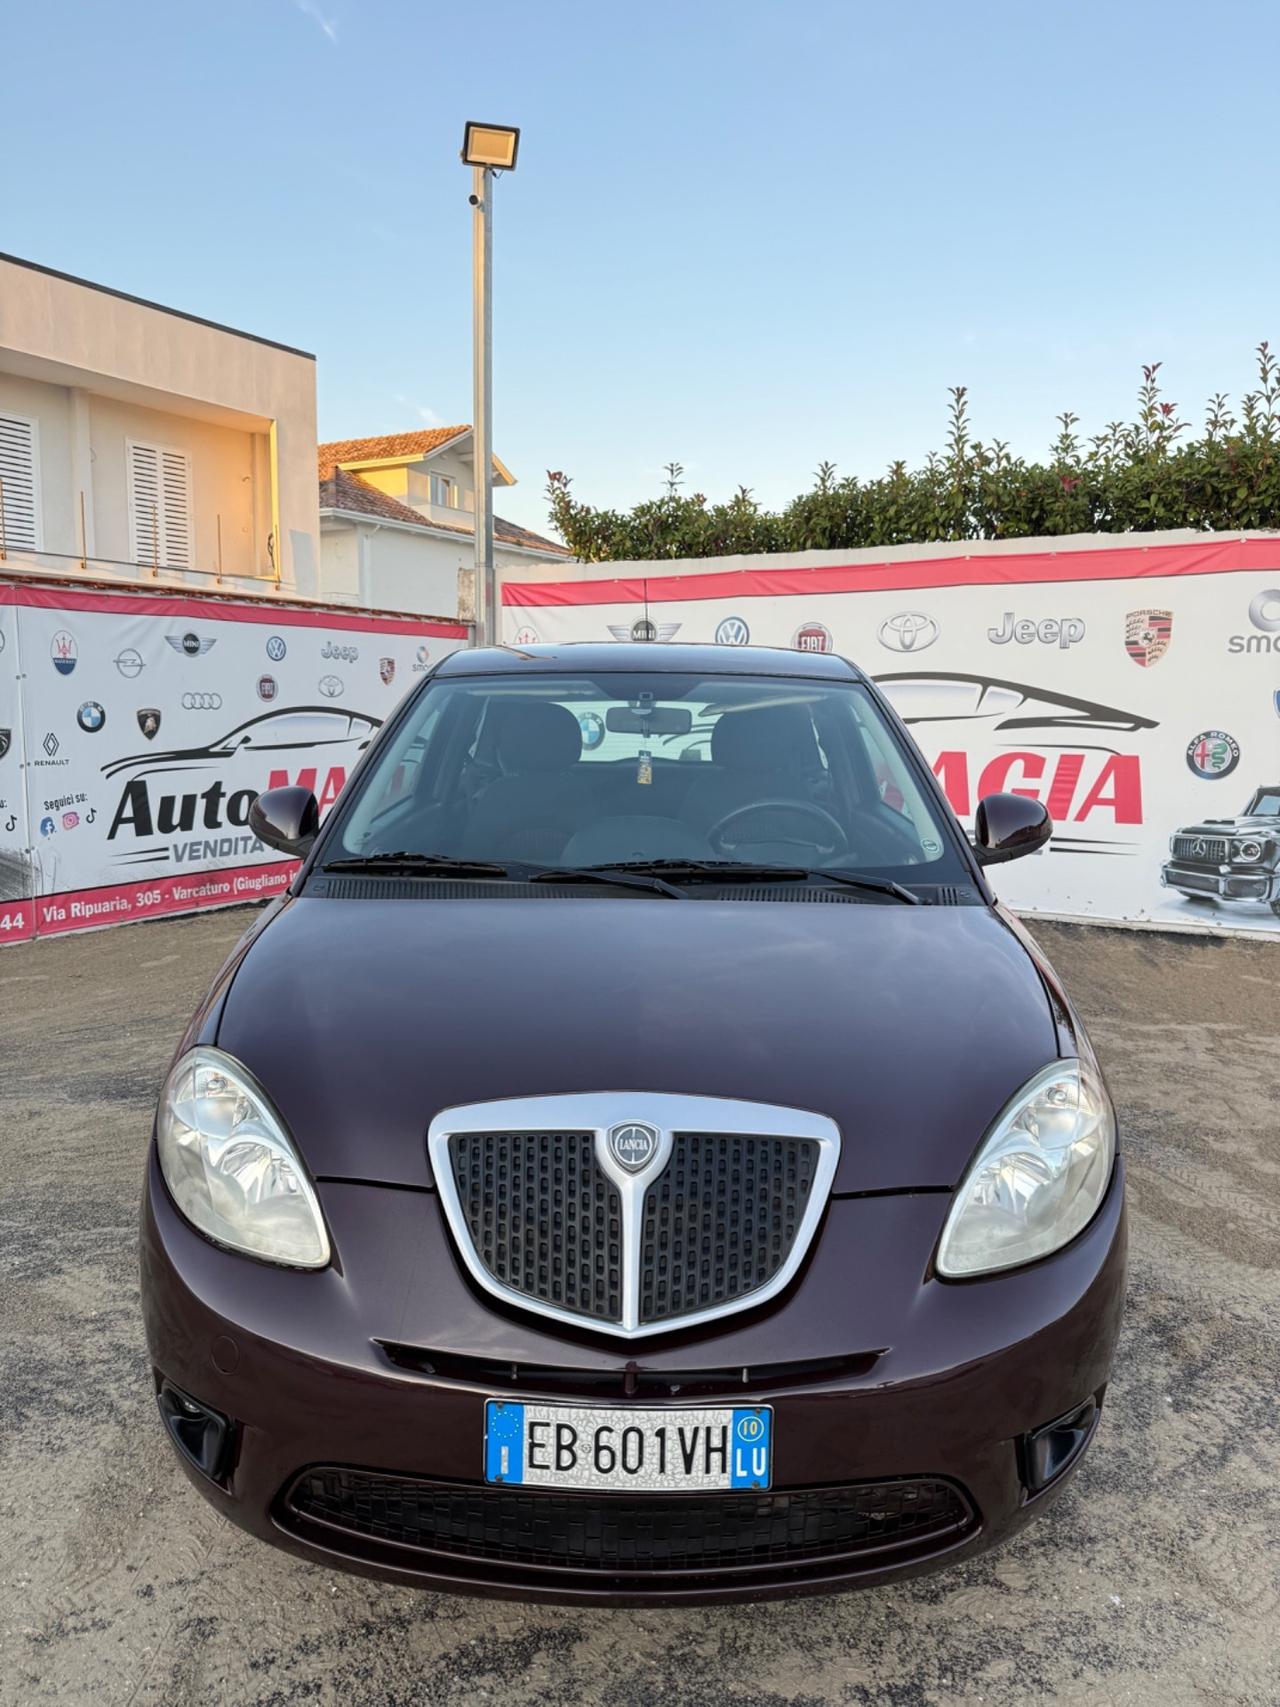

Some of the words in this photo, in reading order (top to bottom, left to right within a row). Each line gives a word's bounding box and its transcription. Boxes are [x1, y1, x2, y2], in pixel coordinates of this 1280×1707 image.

[988, 612, 1086, 649] Jeep
[320, 641, 359, 663] Jeep
[801, 636, 825, 651] FIAT
[34, 759, 70, 767] RENAULT
[44, 795, 75, 811] Seguici
[173, 836, 265, 863] VENDITA
[43, 905, 66, 922] Via
[71, 896, 132, 919] Ripuaria,
[136, 889, 162, 907] 305
[172, 881, 230, 901] Varcaturo
[233, 872, 287, 894] (Giugliano
[619, 1138, 649, 1150] LANCIA
[736, 1448, 767, 1477] LU
